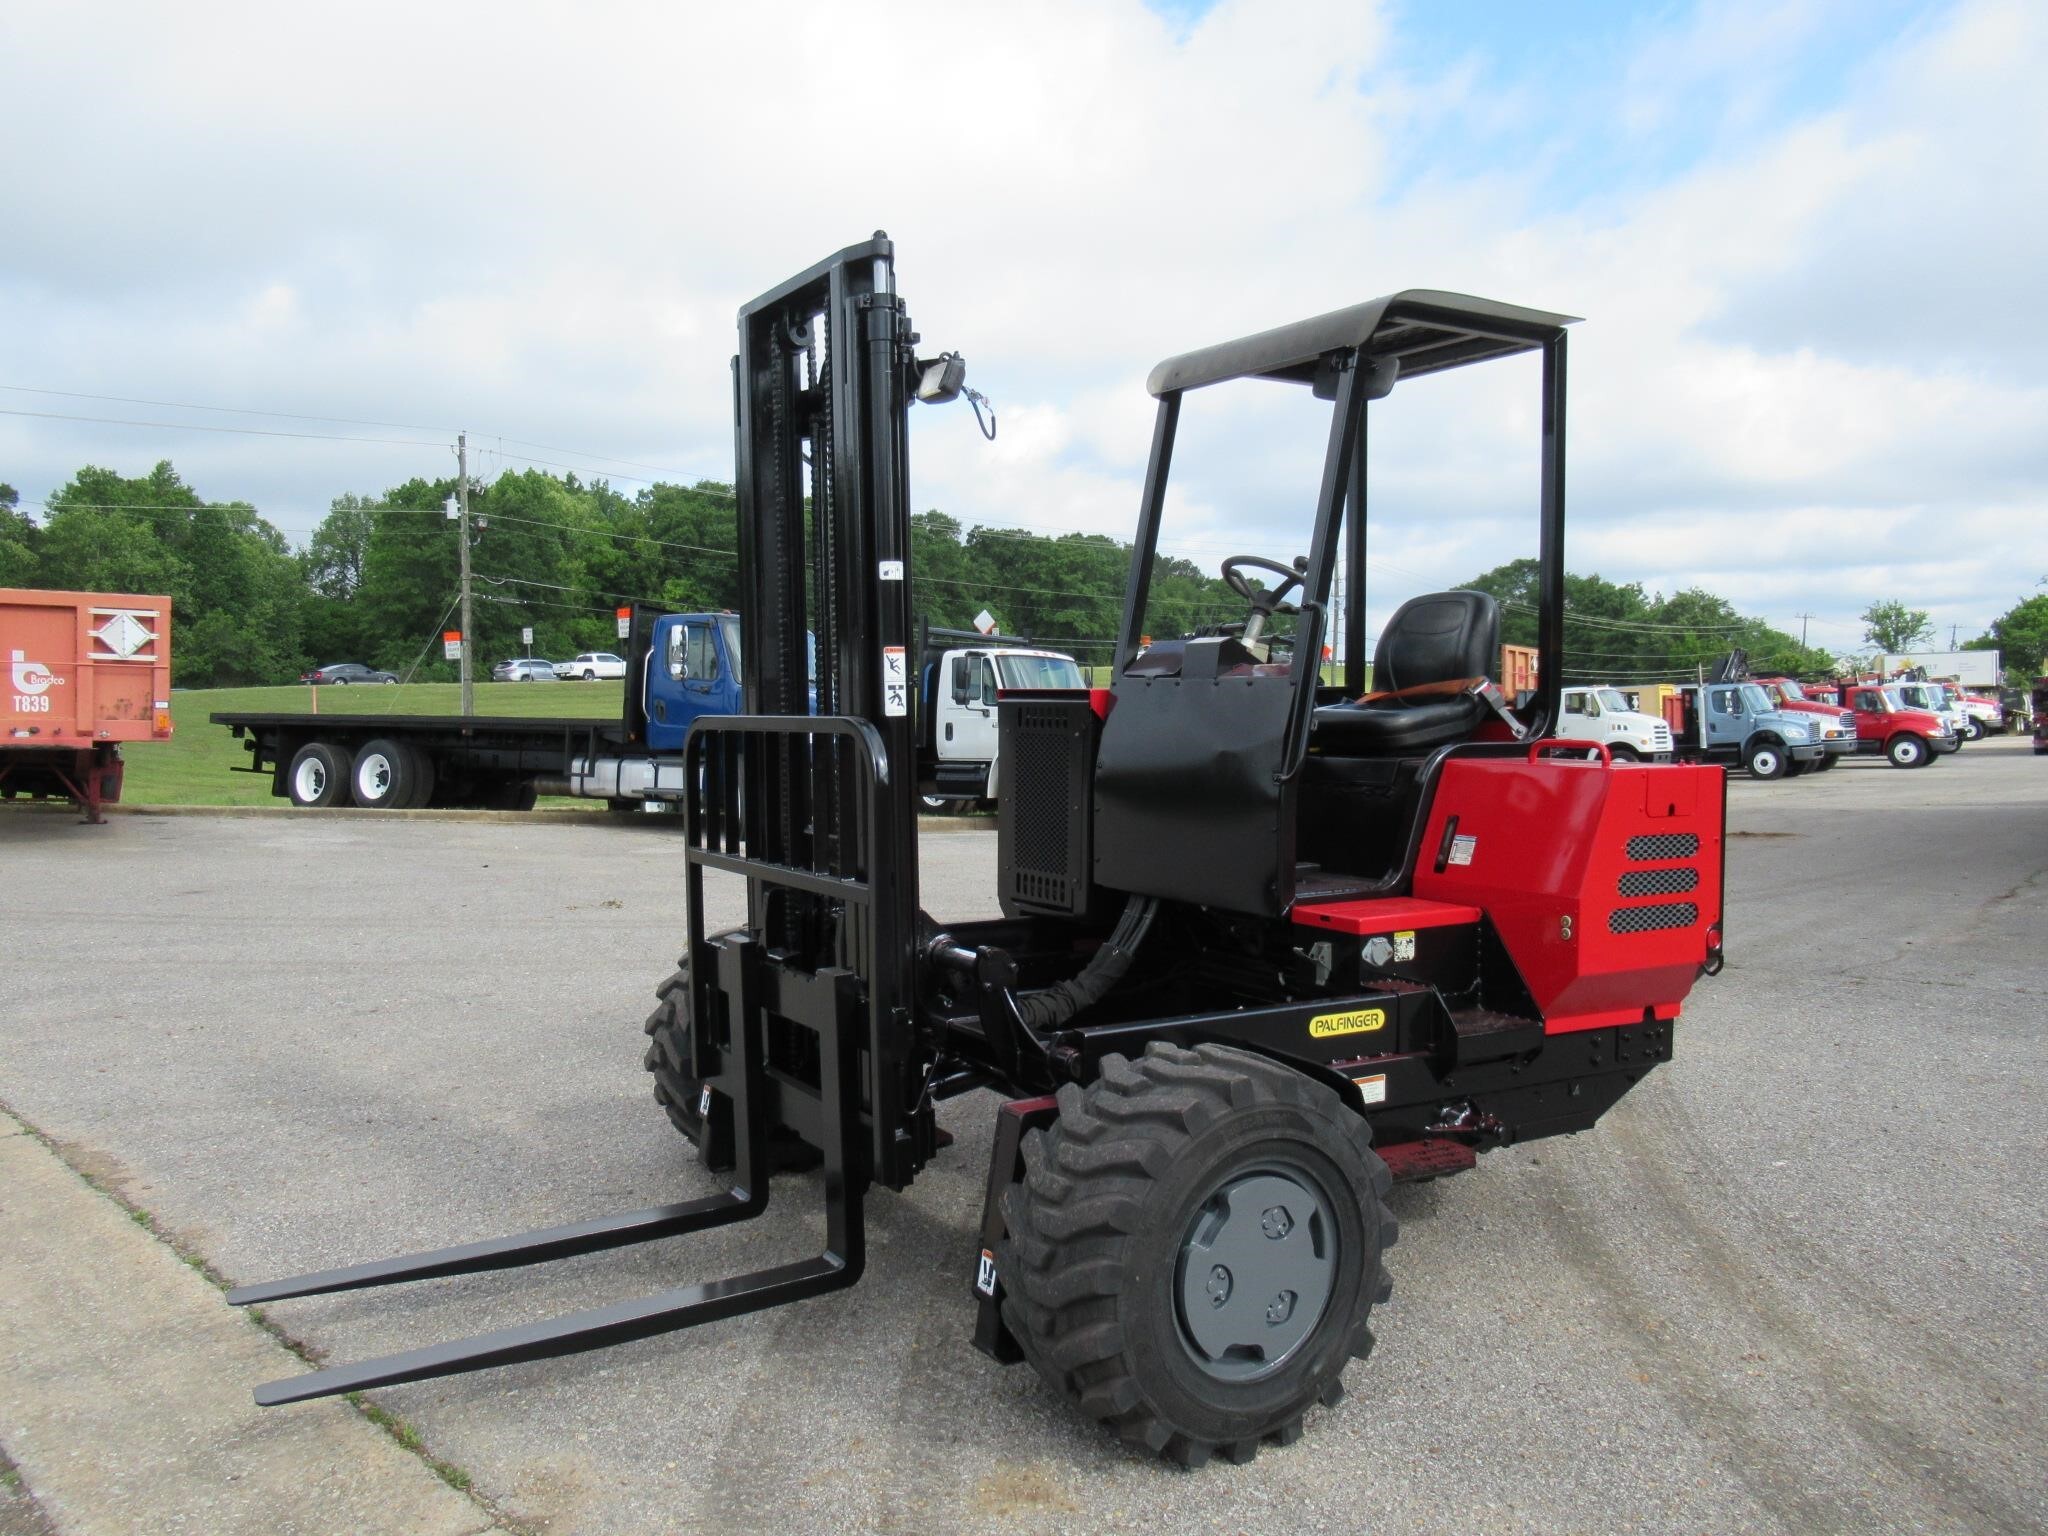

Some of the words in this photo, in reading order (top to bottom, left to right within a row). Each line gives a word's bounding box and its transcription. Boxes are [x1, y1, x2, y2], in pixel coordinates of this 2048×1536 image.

[31, 674, 65, 685] Bradco
[13, 695, 49, 712] T839
[1315, 1013, 1379, 1033] PALFINGER
